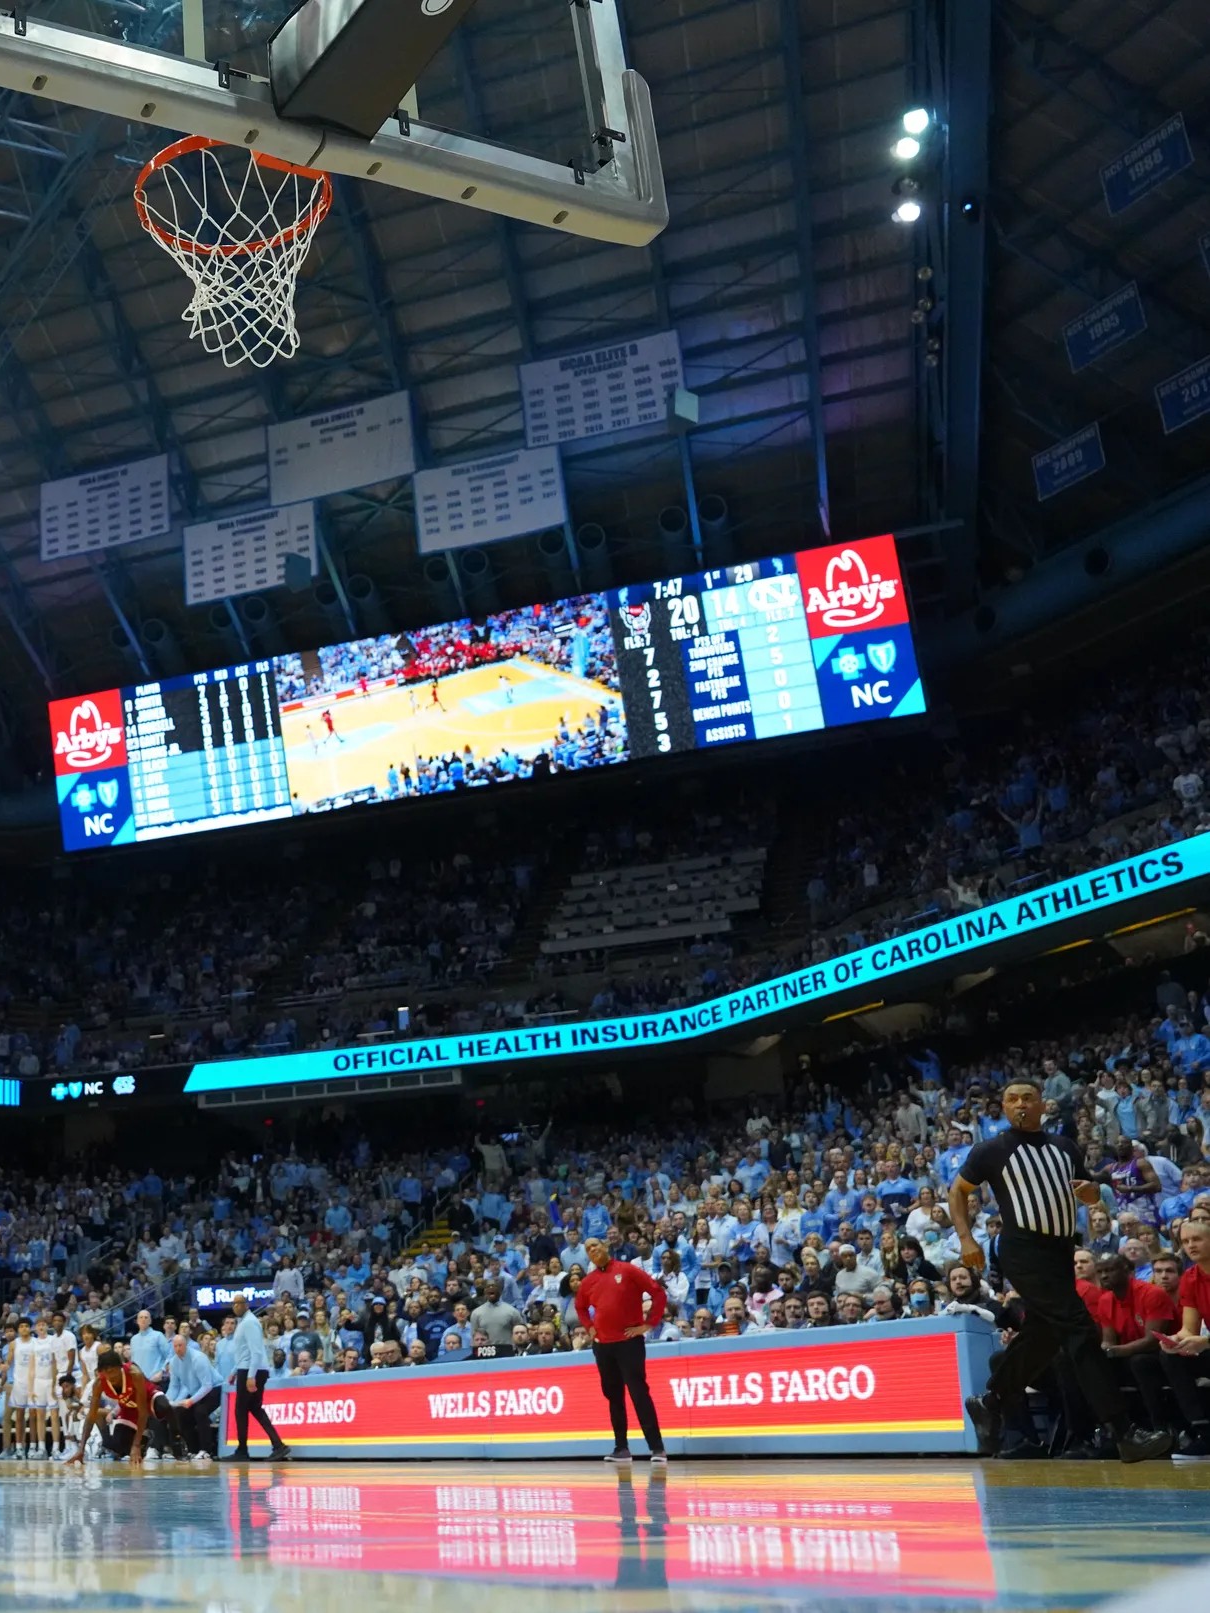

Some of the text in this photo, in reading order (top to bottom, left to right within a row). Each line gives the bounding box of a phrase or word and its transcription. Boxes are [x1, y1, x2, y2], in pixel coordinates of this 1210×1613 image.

[653, 577, 682, 600] 7:47
[733, 564, 753, 584] 29
[710, 587, 739, 618] 14
[806, 574, 898, 613] Arby's
[667, 594, 700, 627] 20
[692, 624, 700, 637] 4
[766, 625, 780, 643] 2
[643, 647, 655, 667] 7
[769, 647, 783, 665] 5
[646, 668, 661, 688] 2
[774, 668, 788, 687] 0
[650, 690, 662, 709] 7
[778, 690, 792, 709] 0
[850, 680, 893, 708] NC
[721, 699, 752, 717] POINTS
[654, 711, 668, 731] 5
[782, 713, 793, 731] 1
[55, 722, 123, 755] Arby's
[657, 733, 671, 752] 3
[705, 723, 747, 742] ASSISTS
[83, 812, 115, 837] NC
[333, 851, 1186, 1072] OFFICIAL HEALTH INSURANCE PARTNER OF CAROLINA ATHLETICS
[84, 1081, 104, 1096] NC
[477, 1346, 496, 1357] POSS
[669, 1364, 876, 1408] WELLS FARGO
[306, 1399, 356, 1424] FARGO
[428, 1385, 564, 1419] WELLS FARGO
